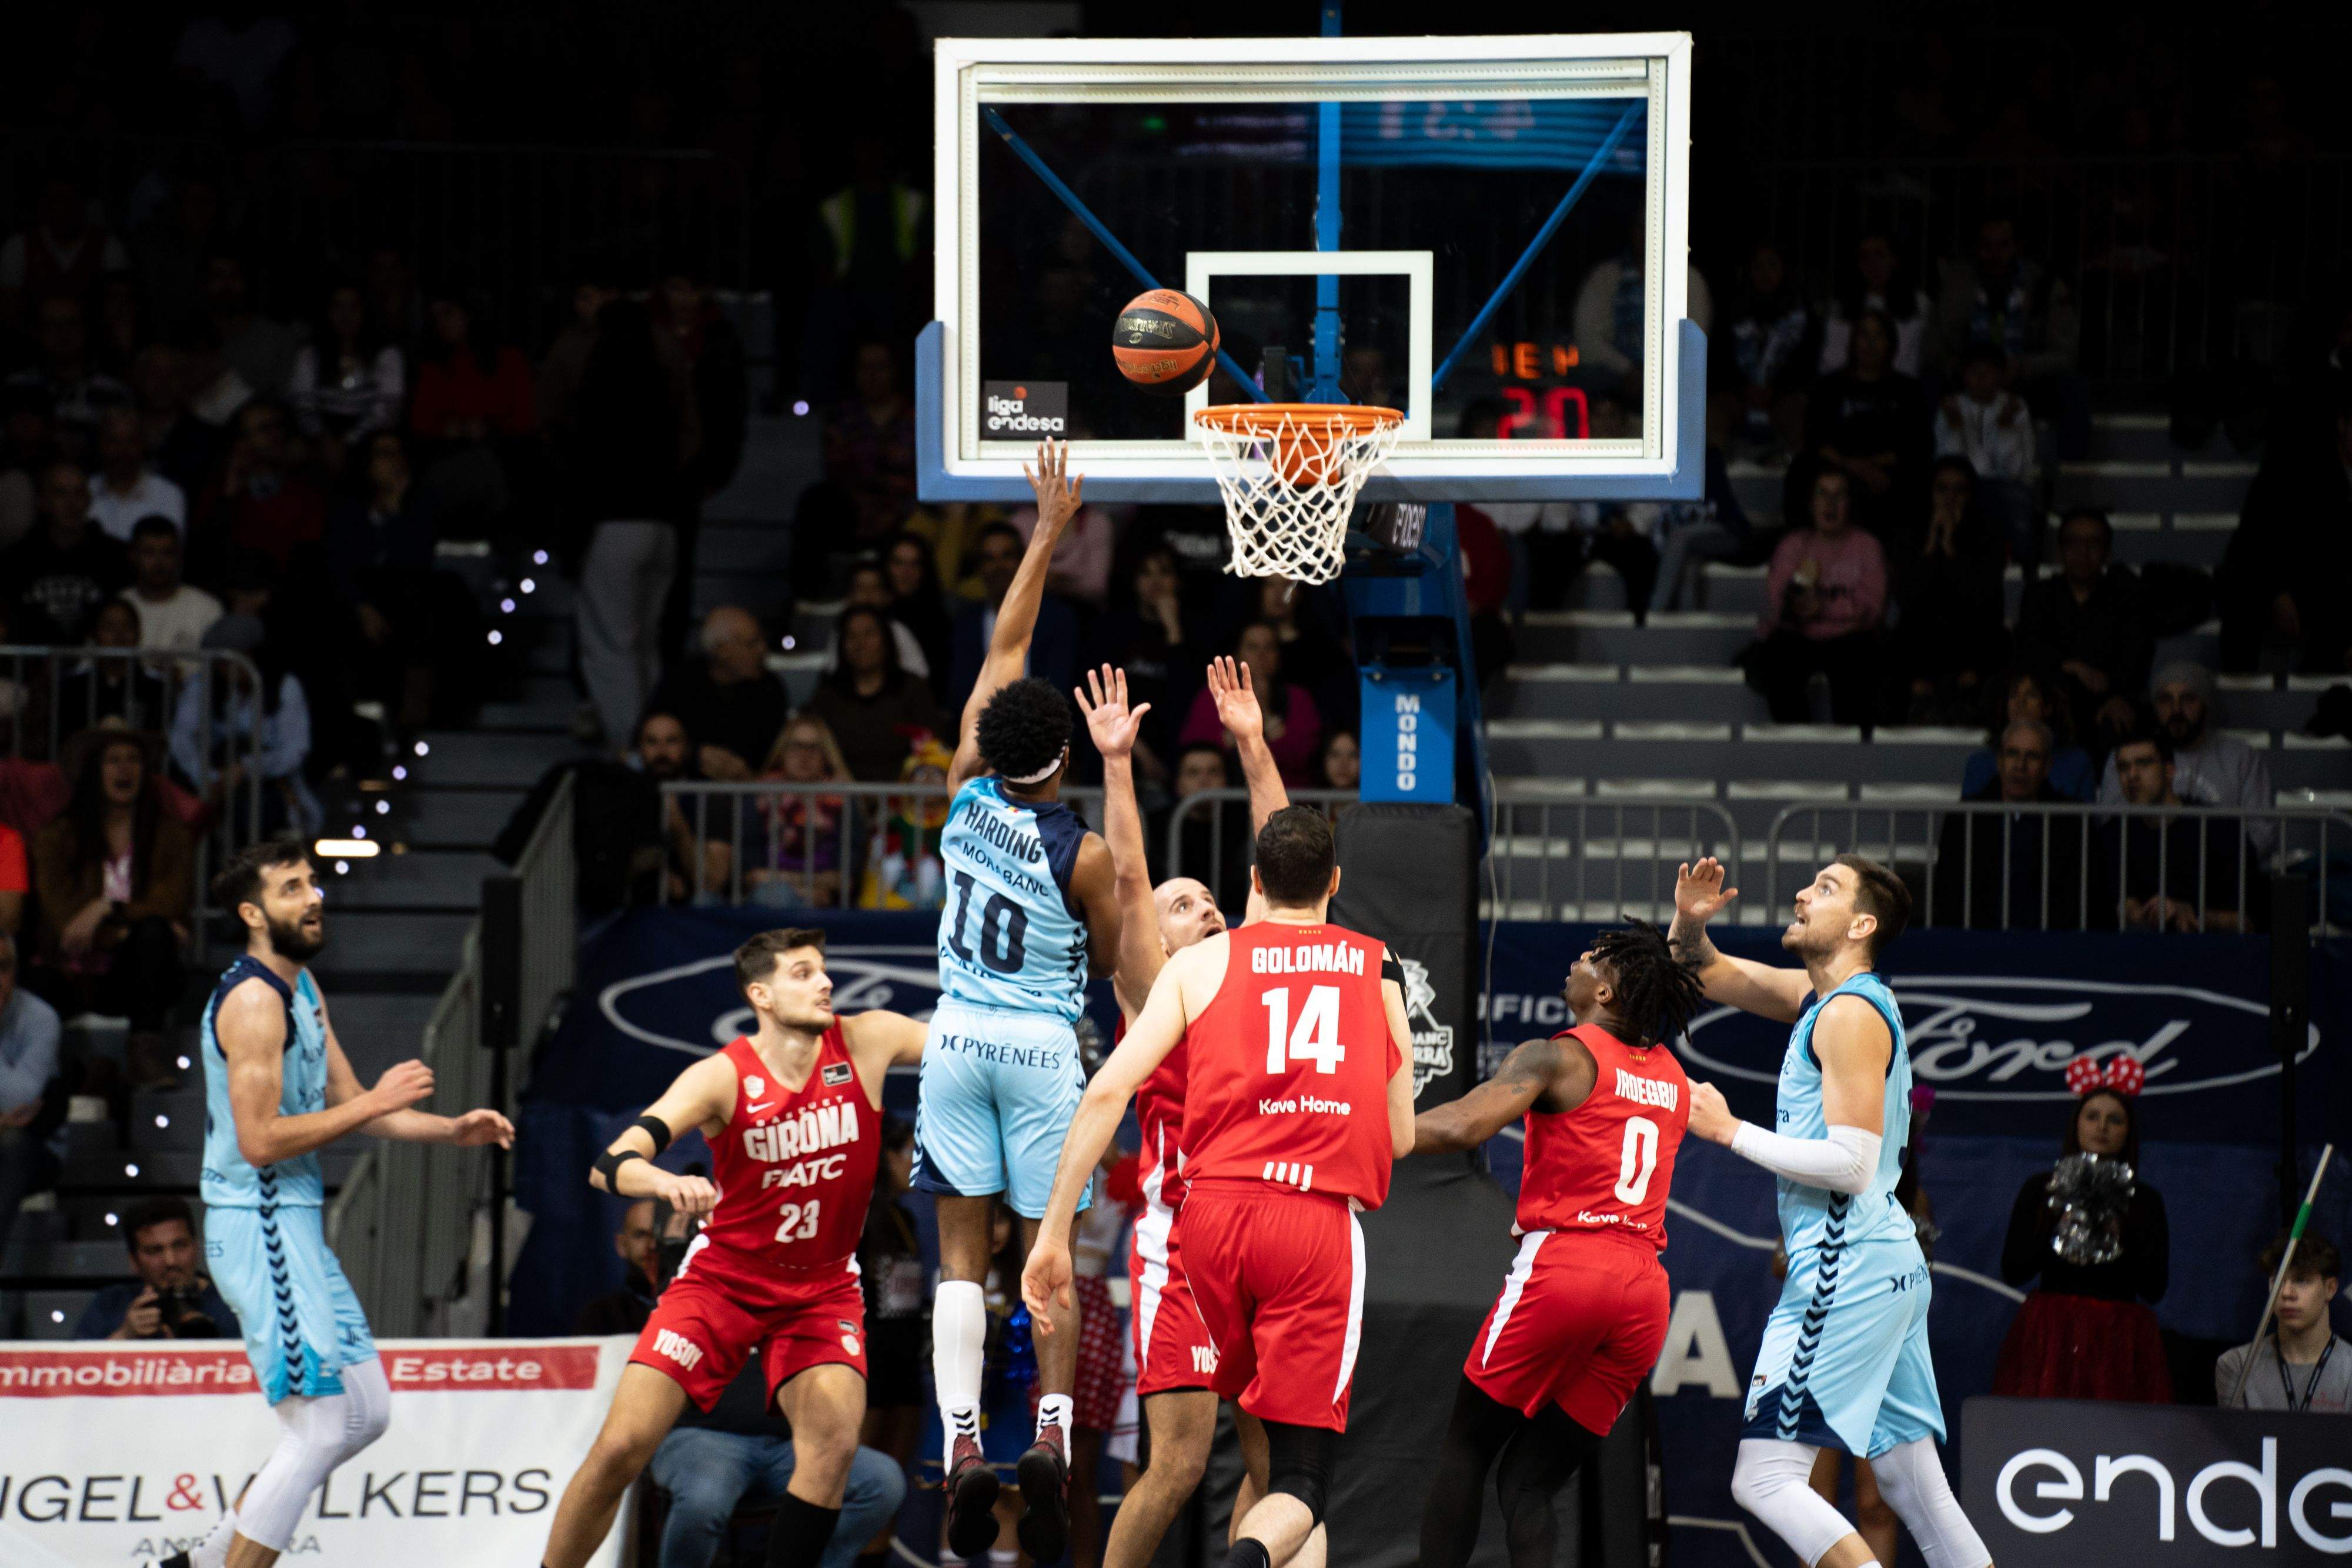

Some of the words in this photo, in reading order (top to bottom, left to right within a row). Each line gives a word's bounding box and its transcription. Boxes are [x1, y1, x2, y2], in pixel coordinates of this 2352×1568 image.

[987, 413, 1064, 432] endesa
[988, 395, 1024, 416] liga
[1395, 694, 1421, 791] MONDO
[964, 802, 1045, 864] HARDING
[948, 871, 1029, 974] 10
[1252, 940, 1365, 977] GOLOMÁN
[1261, 984, 1345, 1075] 14
[962, 1036, 1060, 1069] PYRÉNÉES
[1259, 1098, 1297, 1115] Kave
[1300, 1095, 1351, 1116] Home
[1615, 1067, 1678, 1113] IROEGBU
[743, 1102, 860, 1163] GIRONA
[1614, 1115, 1659, 1206] 0
[775, 1199, 820, 1243] 23
[390, 1357, 542, 1382] Estate
[652, 1328, 704, 1372] YOSOY
[1996, 1436, 2352, 1555] ende
